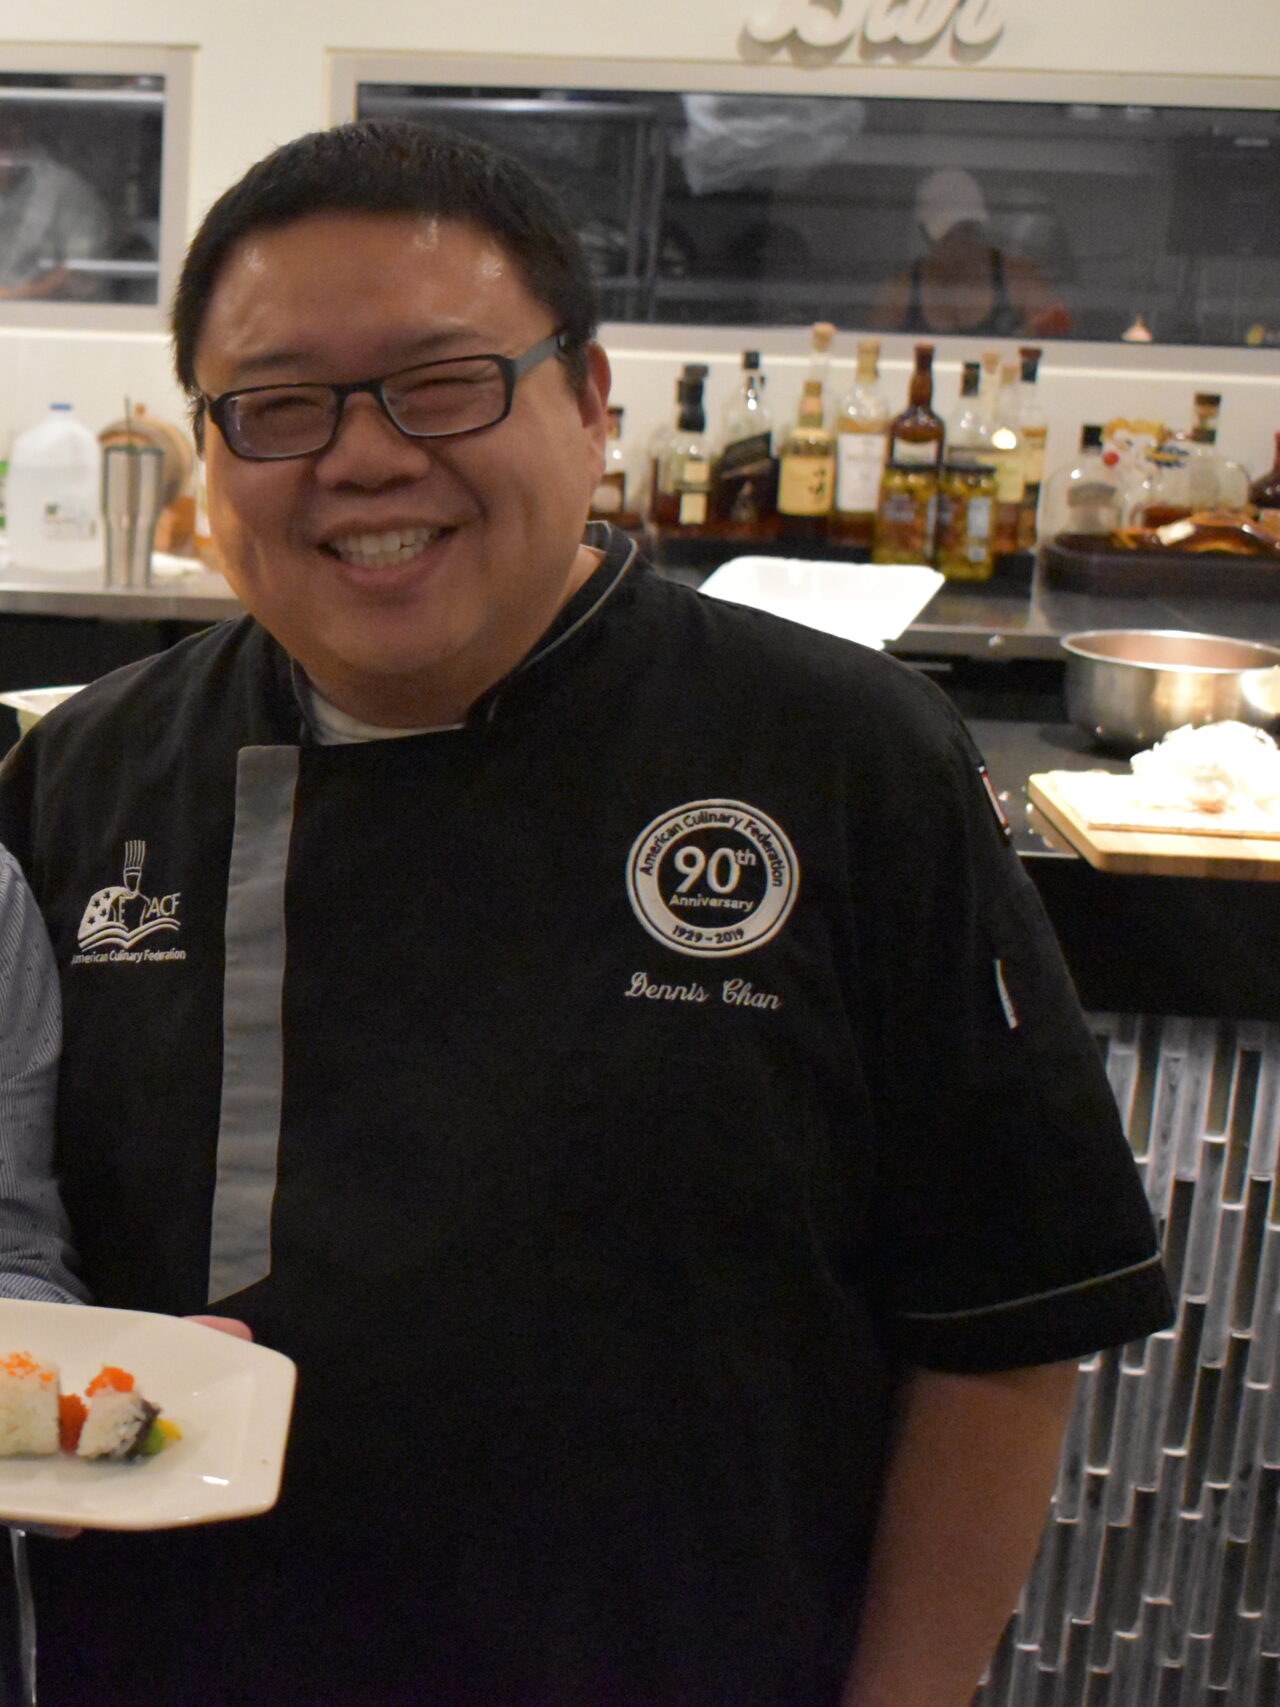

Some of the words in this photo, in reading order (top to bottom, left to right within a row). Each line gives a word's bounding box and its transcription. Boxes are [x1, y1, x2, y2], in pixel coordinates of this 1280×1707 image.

[639, 822, 684, 877] American
[683, 811, 744, 830] Culinary
[744, 820, 786, 888] Federation
[674, 845, 757, 894] 90th
[146, 892, 181, 918] ACF
[669, 893, 754, 912] Anniversary
[672, 925, 703, 942] 1929
[715, 928, 745, 944] 2019
[109, 949, 143, 963] Culinary
[144, 948, 186, 961] Federation
[624, 971, 709, 1002] Dennis
[722, 978, 781, 1010] Chan
